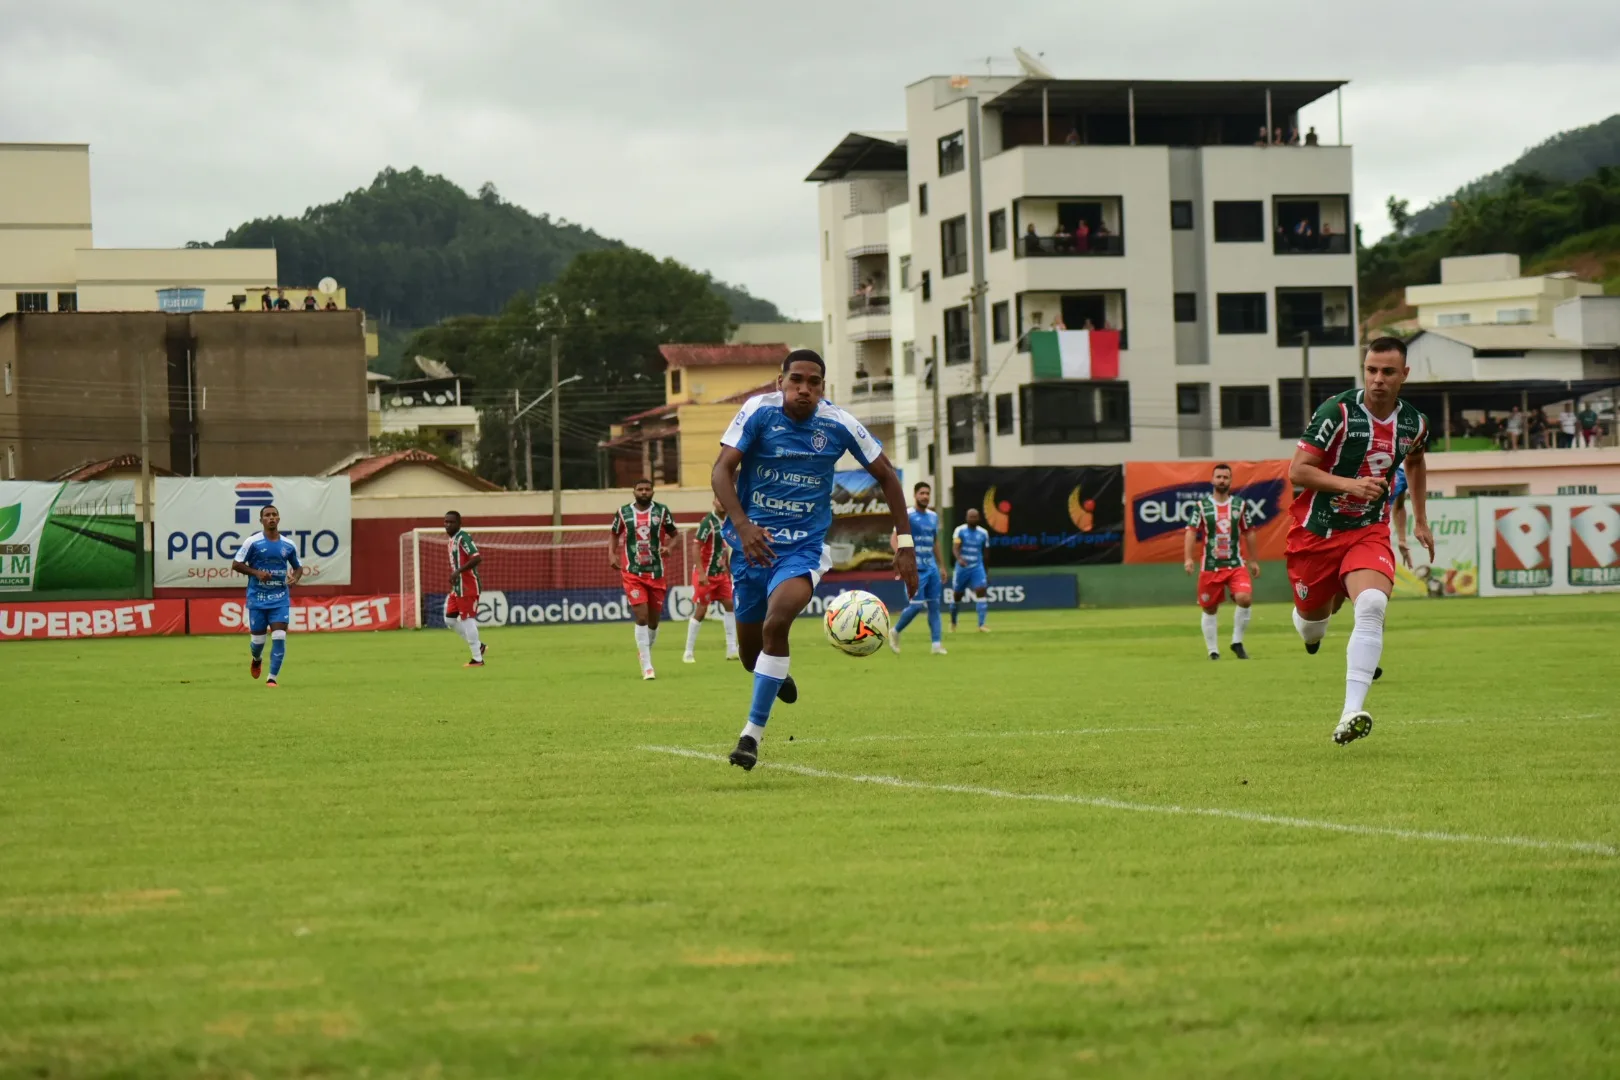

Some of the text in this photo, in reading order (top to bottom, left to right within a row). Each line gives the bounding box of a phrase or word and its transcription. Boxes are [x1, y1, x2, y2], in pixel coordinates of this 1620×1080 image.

[766, 497, 816, 513] OKEY
[219, 597, 390, 630] SERBET
[510, 594, 632, 624] nacional
